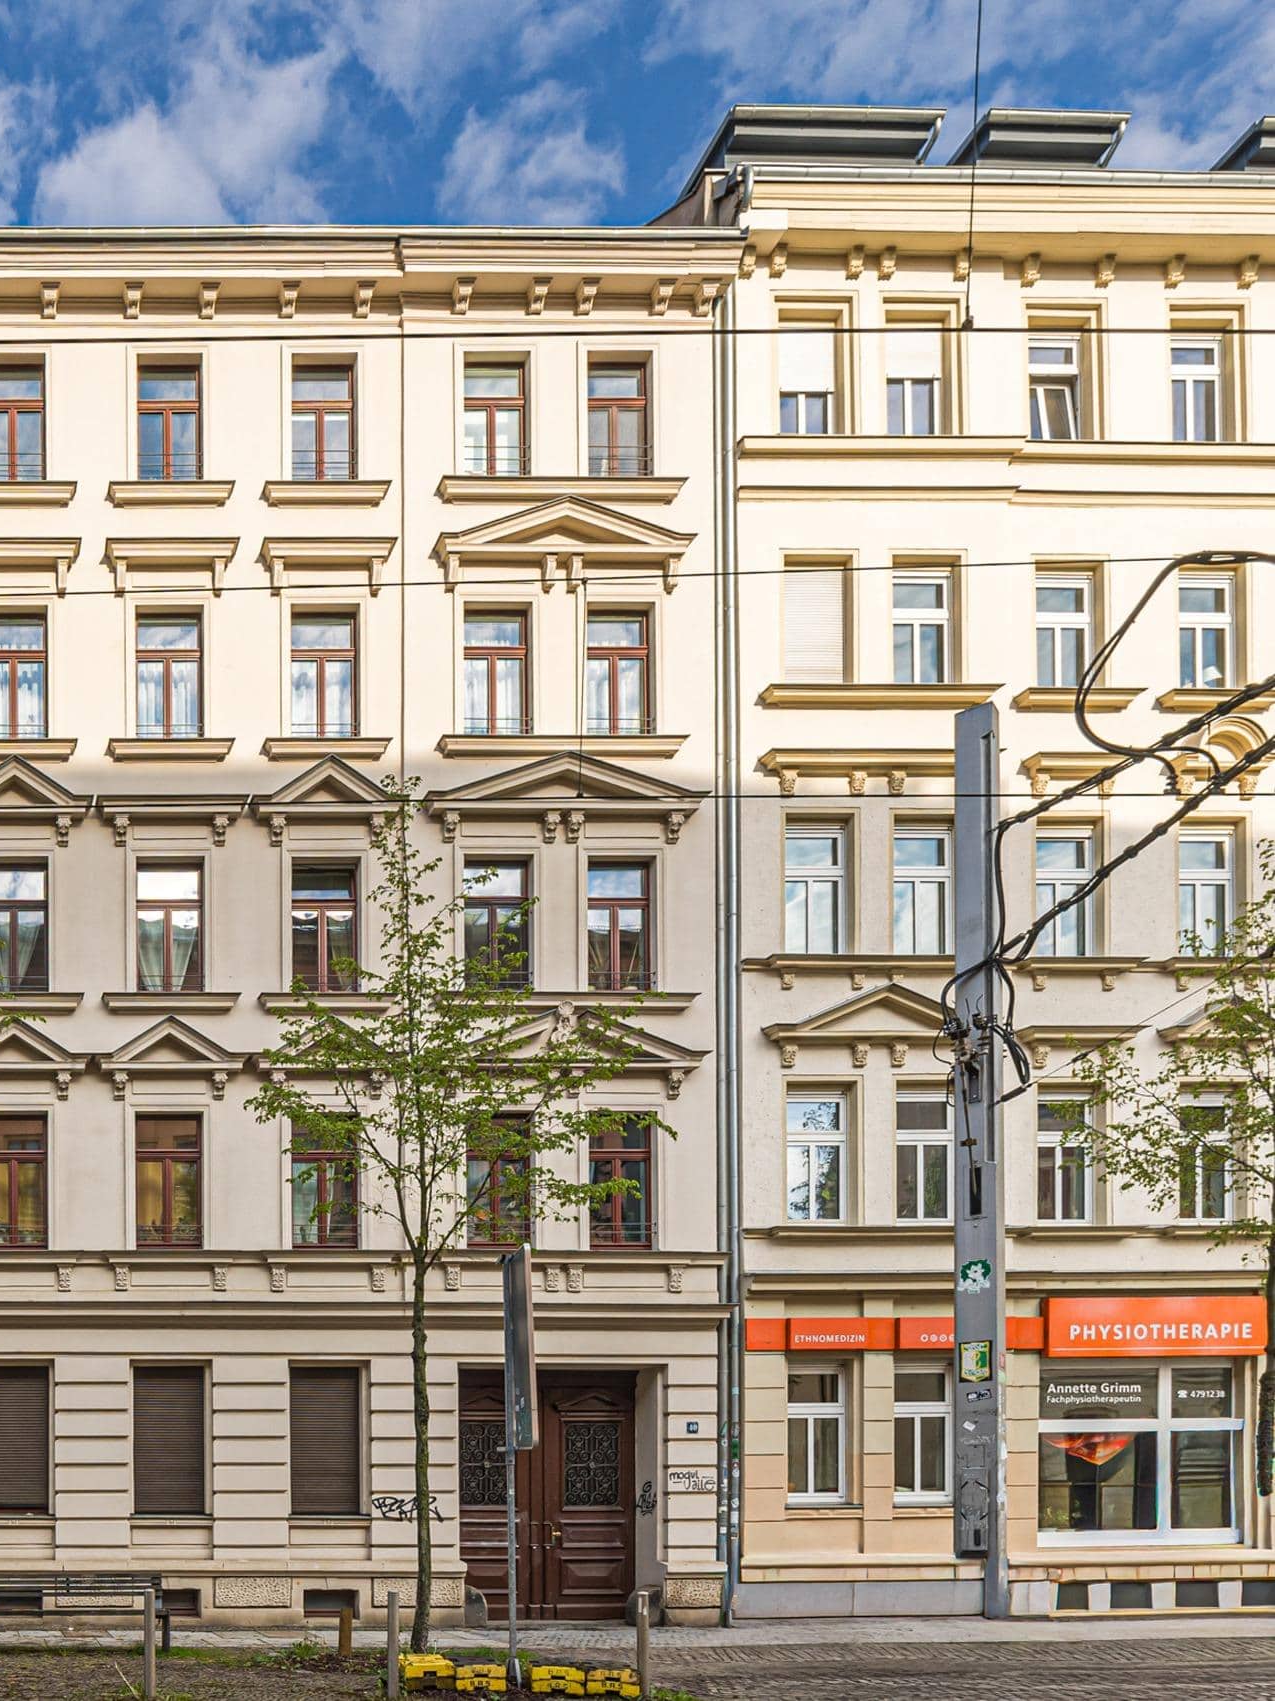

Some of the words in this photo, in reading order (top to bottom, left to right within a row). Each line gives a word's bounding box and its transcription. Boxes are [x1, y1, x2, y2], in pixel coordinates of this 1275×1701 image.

[1069, 1323, 1253, 1341] PHYSIOTHERAPIE
[794, 1334, 866, 1344] ETHNOMEDIZIN
[1047, 1383, 1097, 1393] Annette
[1100, 1382, 1142, 1393] Grimm
[1046, 1395, 1142, 1404] Fachphysiotherapeutin
